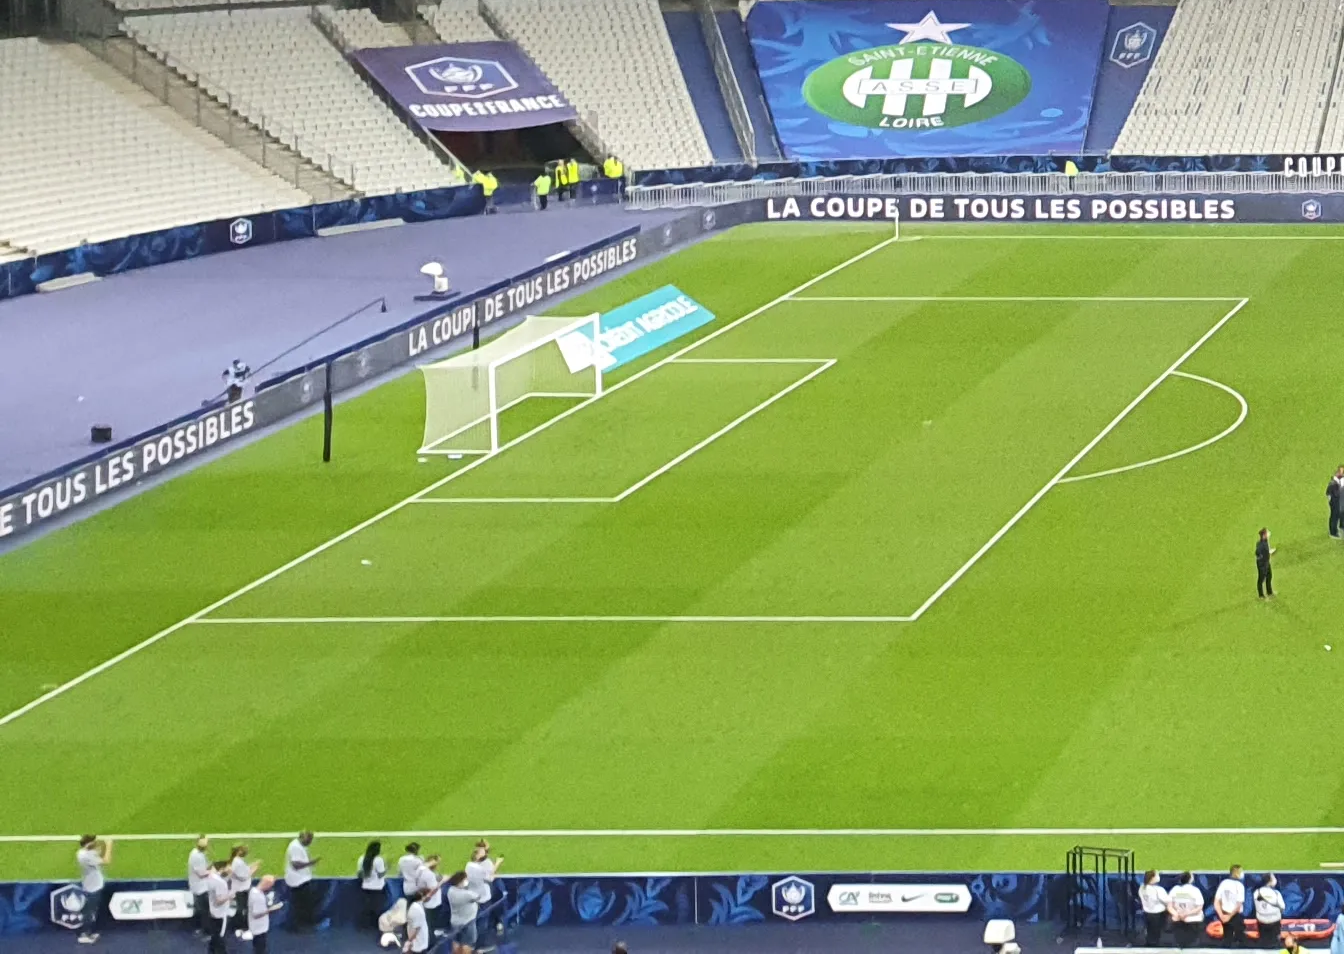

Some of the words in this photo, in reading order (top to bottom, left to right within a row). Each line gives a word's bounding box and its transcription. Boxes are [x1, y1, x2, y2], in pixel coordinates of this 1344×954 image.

[879, 116, 944, 129] LOIRE
[766, 197, 801, 219] LA
[810, 197, 896, 219] COUPE
[909, 197, 945, 219] DE
[953, 197, 1025, 219] TOUS
[1034, 197, 1081, 219] LES
[1090, 197, 1235, 219] POSSIBLES
[408, 325, 428, 356] LA
[484, 293, 504, 323] DE
[506, 275, 544, 312] TOUS
[546, 268, 571, 296] LES
[572, 237, 638, 285] POSSIBLES
[22, 472, 87, 525] TOUS
[95, 450, 135, 496] LES
[143, 400, 254, 474] POSSIBLES
